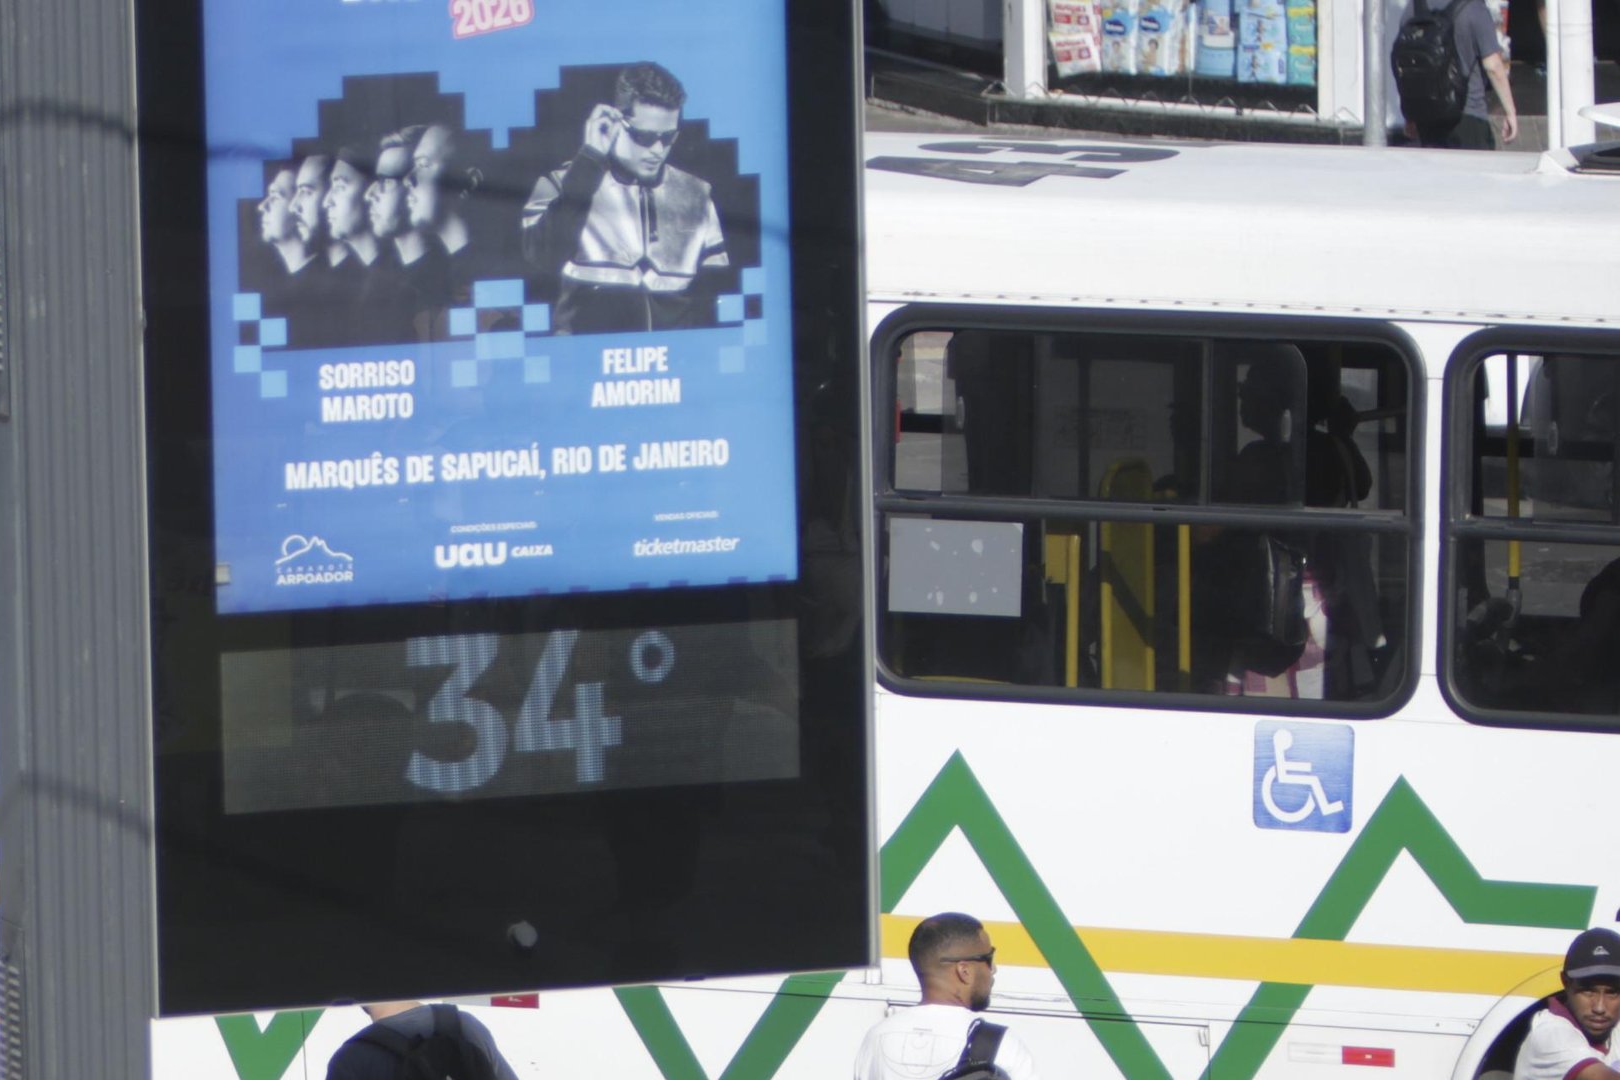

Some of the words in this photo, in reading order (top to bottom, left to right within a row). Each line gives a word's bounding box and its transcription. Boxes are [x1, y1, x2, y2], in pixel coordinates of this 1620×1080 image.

[602, 346, 669, 374] FELIPE
[319, 360, 415, 390] SORRISO
[591, 378, 681, 407] AMORIM
[322, 393, 414, 423] MAROTO
[285, 452, 399, 490] MARQUÊS
[406, 456, 434, 484] DE
[441, 442, 546, 482] SAPUCAÍ,
[552, 447, 592, 475] RIO
[599, 444, 627, 472] DE
[633, 439, 730, 471] JANEIRO
[511, 544, 554, 557] CAIXA
[633, 536, 740, 557] ticketmaster
[276, 571, 354, 585] ARPOADOR
